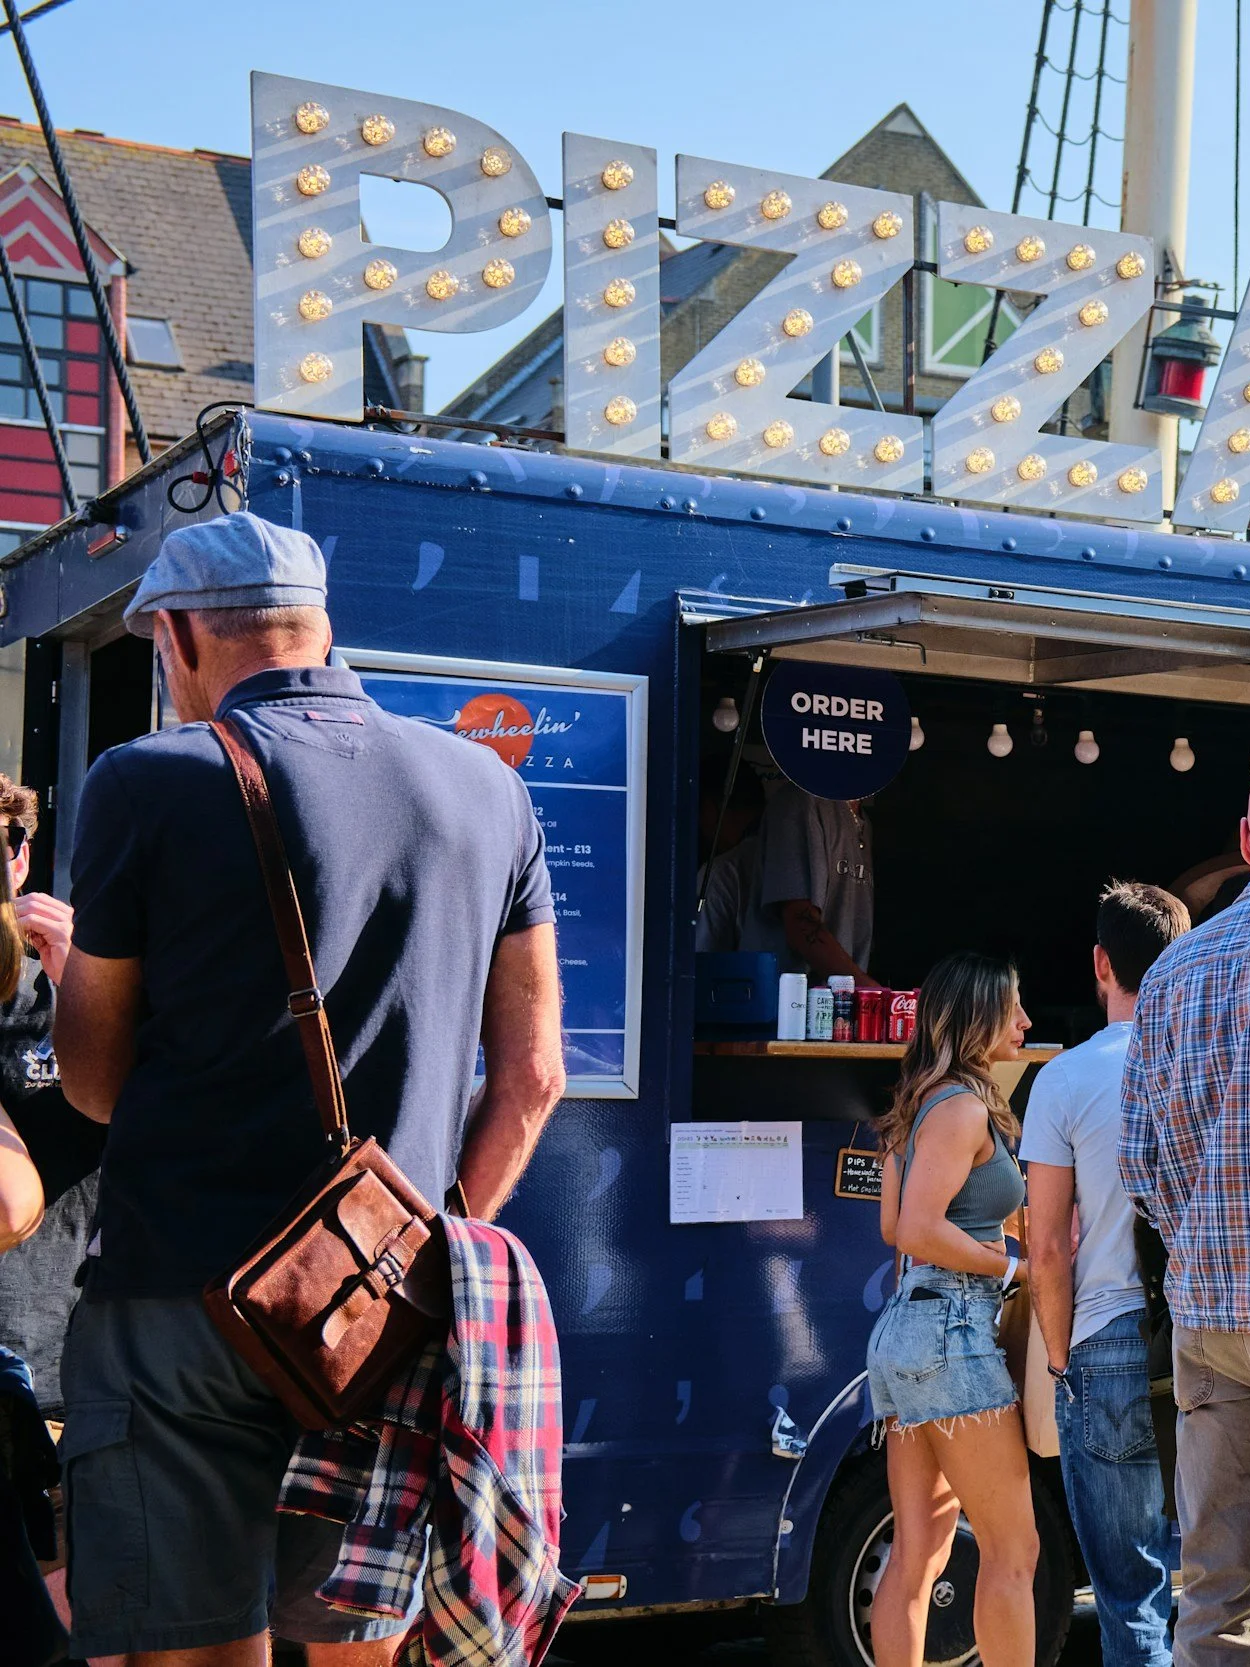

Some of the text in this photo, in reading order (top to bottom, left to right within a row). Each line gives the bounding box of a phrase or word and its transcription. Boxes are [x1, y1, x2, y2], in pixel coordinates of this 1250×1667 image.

[791, 692, 884, 721] ORDER
[802, 727, 873, 755] HERE
[547, 820, 557, 828] Oil
[574, 844, 592, 854] £13
[571, 859, 595, 868] Seeds,
[562, 909, 582, 917] Basil,
[559, 958, 588, 967] Cheese,
[847, 1157, 866, 1167] DIPS
